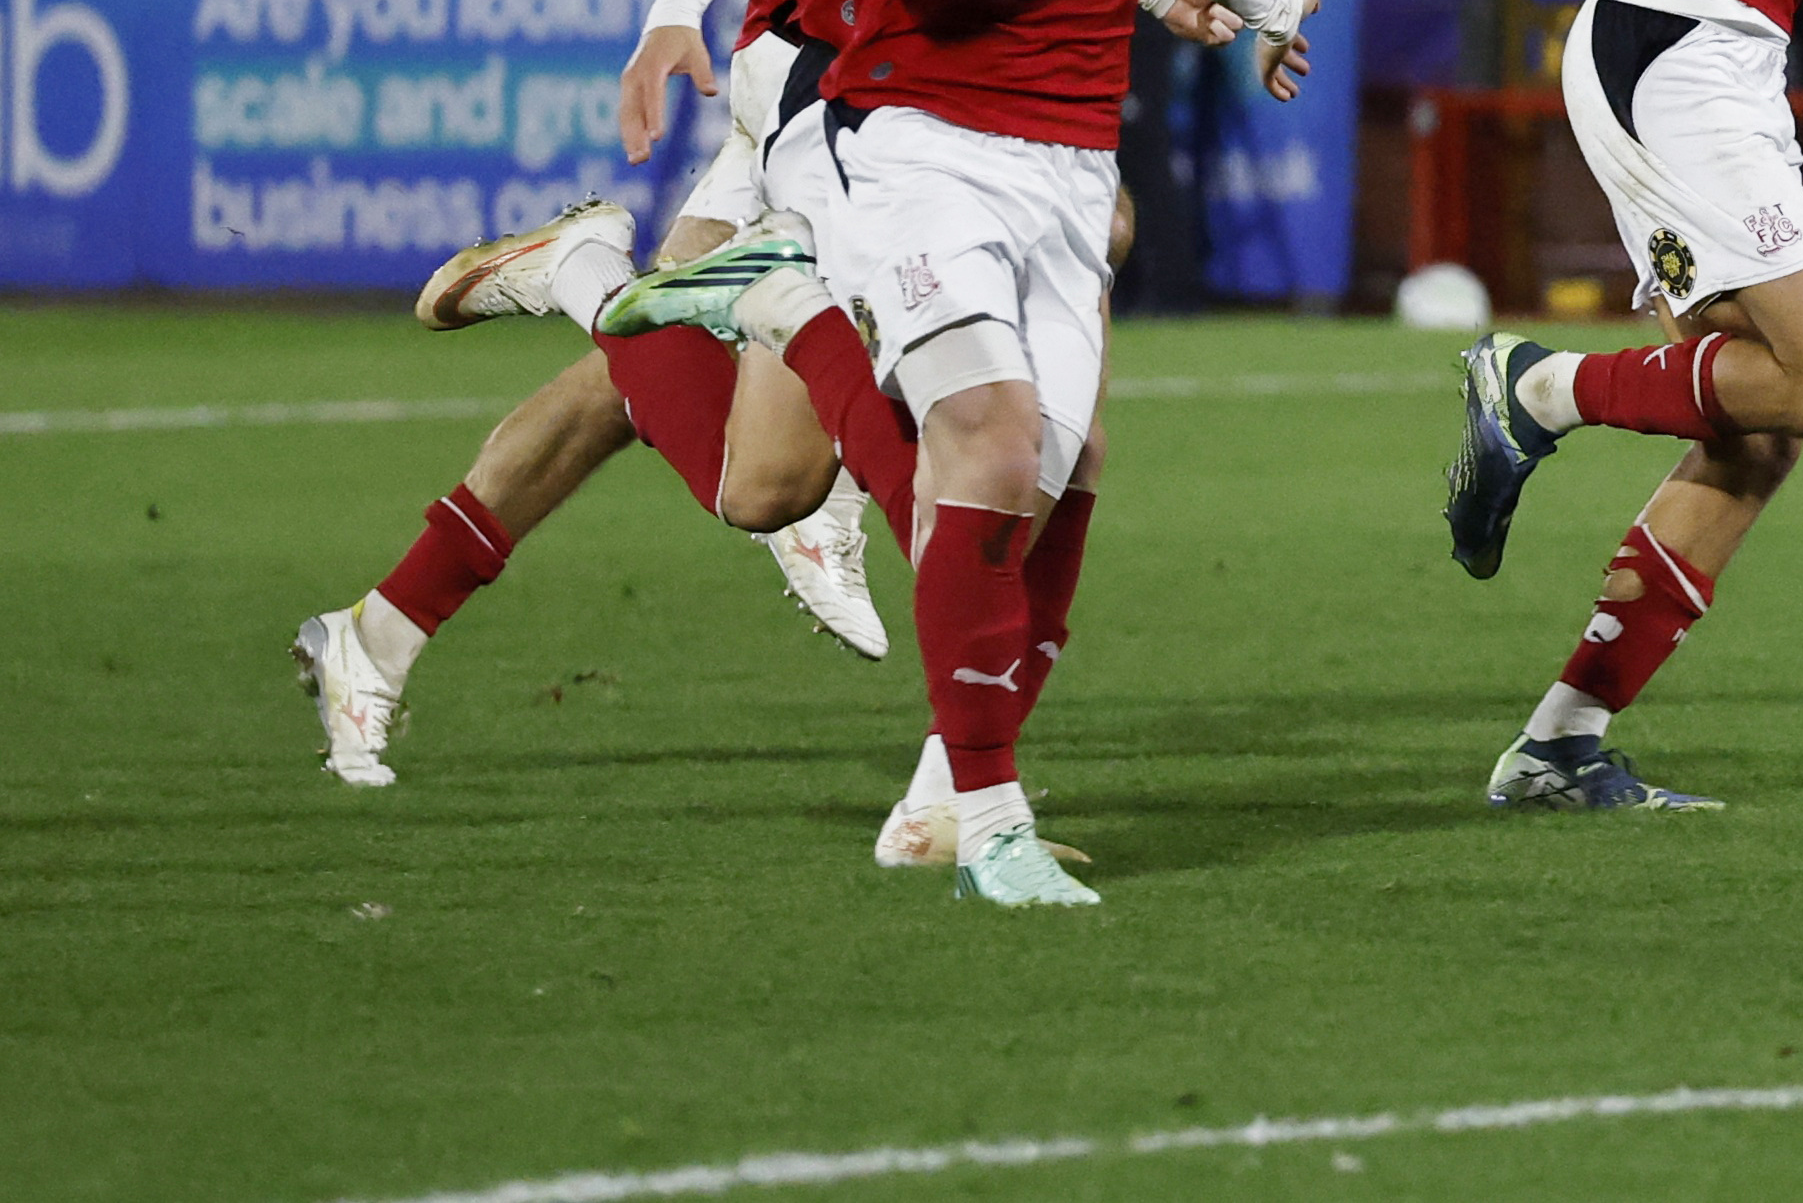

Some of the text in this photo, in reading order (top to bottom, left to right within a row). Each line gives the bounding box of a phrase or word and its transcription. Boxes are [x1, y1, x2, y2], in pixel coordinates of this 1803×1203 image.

[196, 53, 623, 170] scale and gro
[192, 155, 484, 253] business
